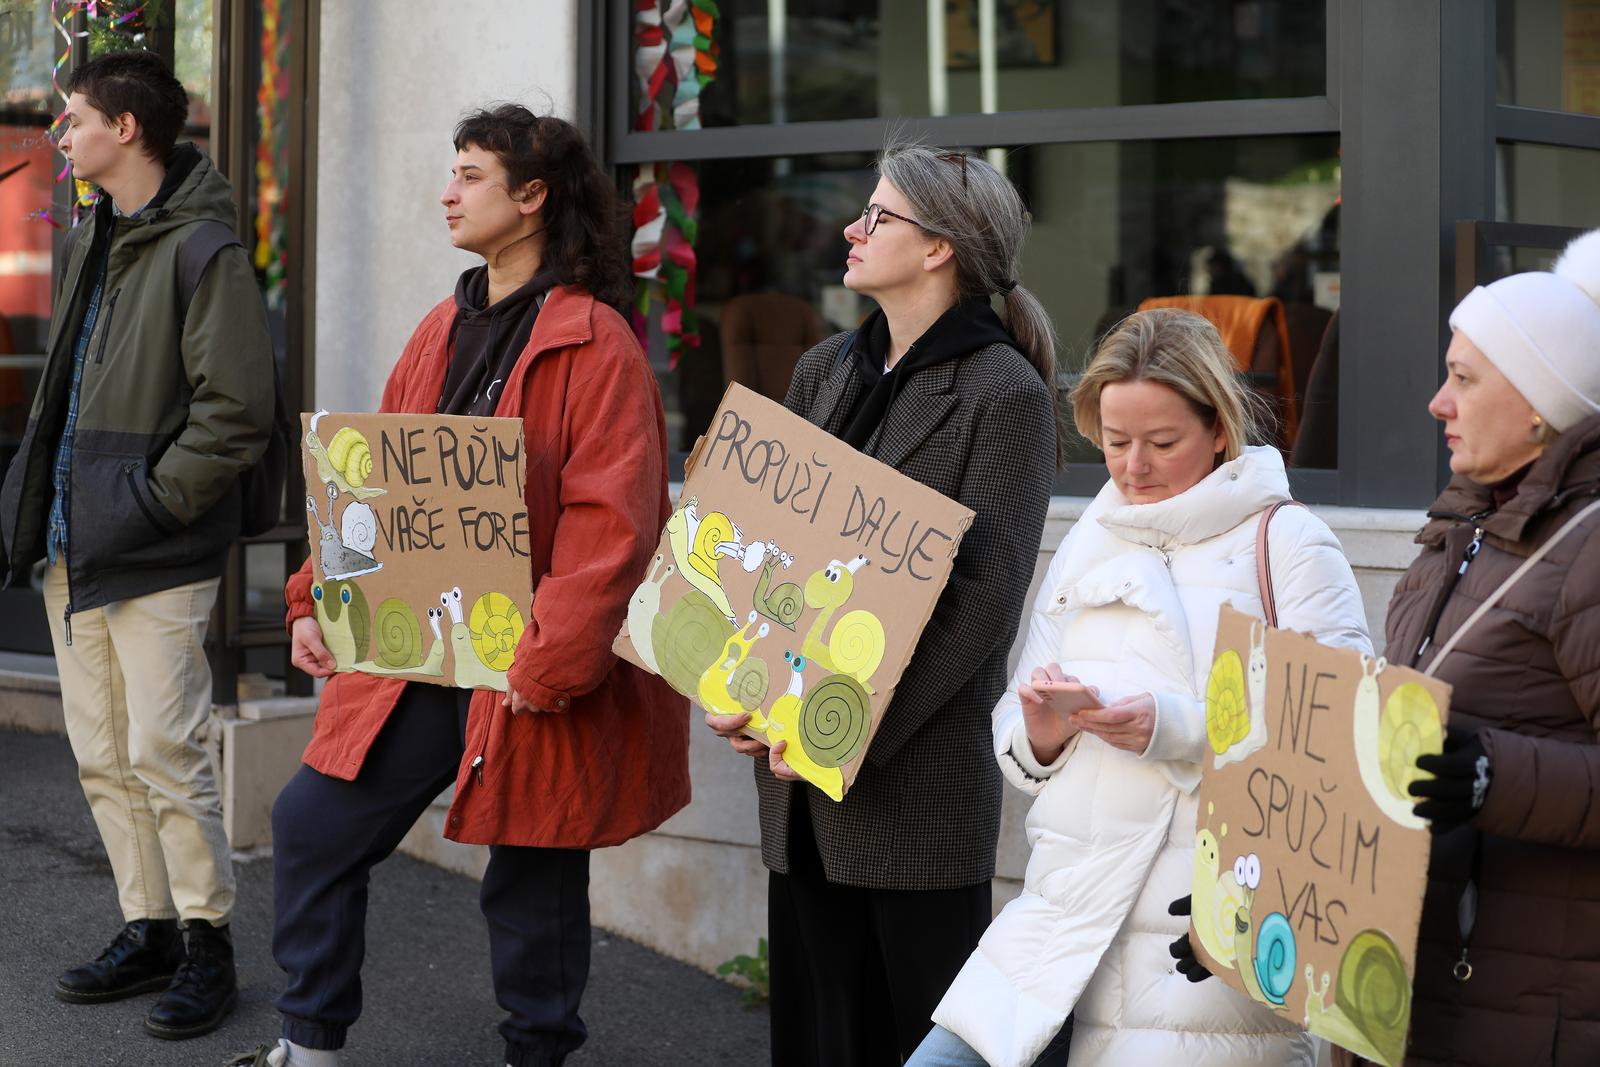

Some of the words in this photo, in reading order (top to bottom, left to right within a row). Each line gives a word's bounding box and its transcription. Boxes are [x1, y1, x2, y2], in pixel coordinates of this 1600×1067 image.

[381, 427, 432, 486] NE
[703, 409, 833, 524] PROPUŽI
[374, 495, 446, 553] VAŠE
[458, 506, 531, 557] FORE
[1276, 662, 1337, 763] NE
[1242, 768, 1381, 894] SPUŽIM
[1276, 867, 1348, 946] VAS
